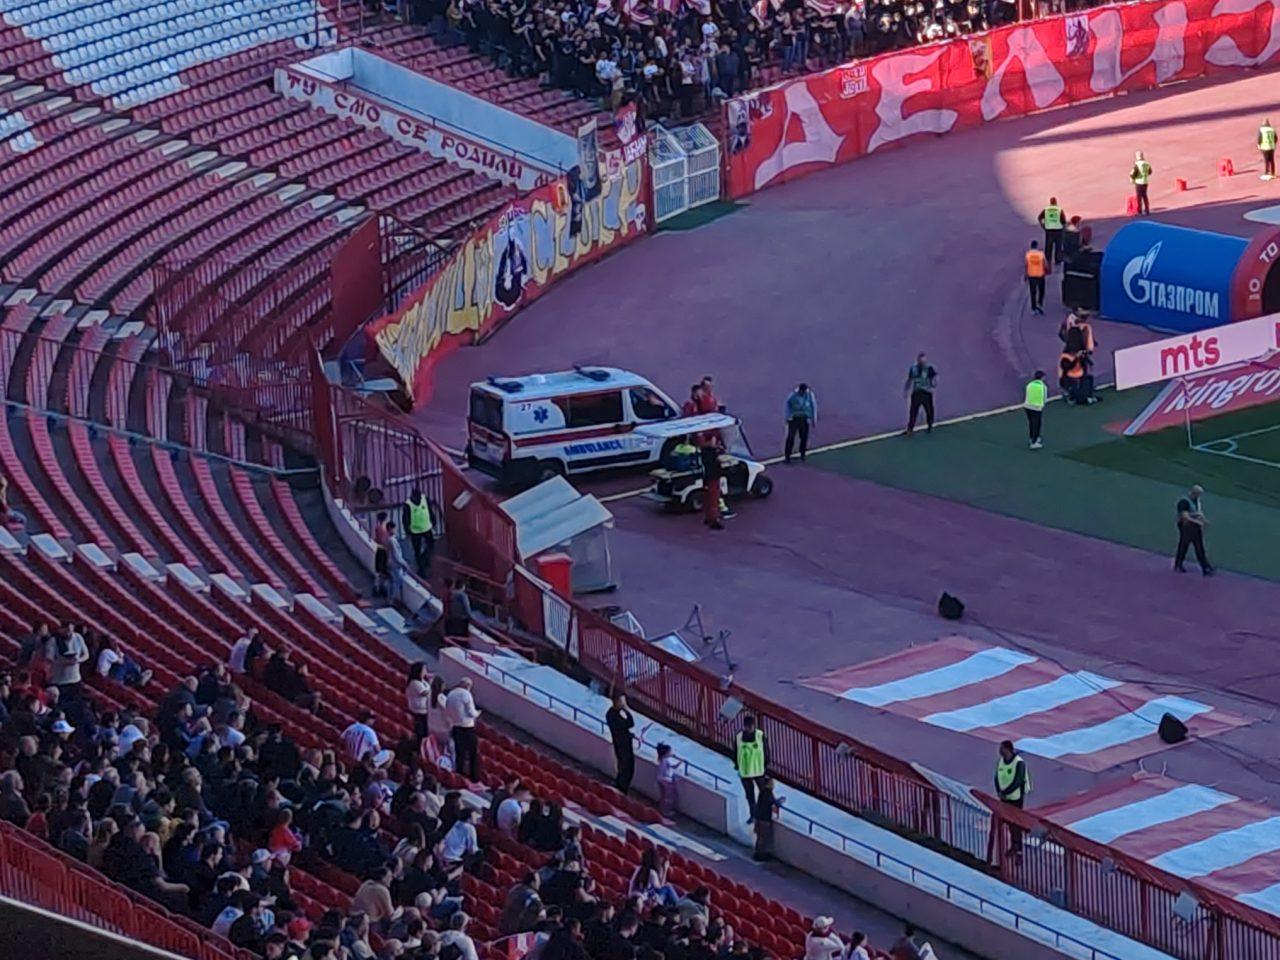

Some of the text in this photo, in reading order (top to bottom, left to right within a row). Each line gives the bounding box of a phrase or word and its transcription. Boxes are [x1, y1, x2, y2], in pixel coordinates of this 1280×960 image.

[287, 74, 317, 97] ТУ
[334, 93, 381, 124] СМО
[396, 117, 430, 143] СЕ
[441, 135, 524, 181] РОДИЛИ
[1259, 242, 1279, 263] ТО
[1150, 280, 1219, 319] ГАЗПРОМ
[1161, 336, 1220, 376] mts
[520, 403, 532, 412] 27
